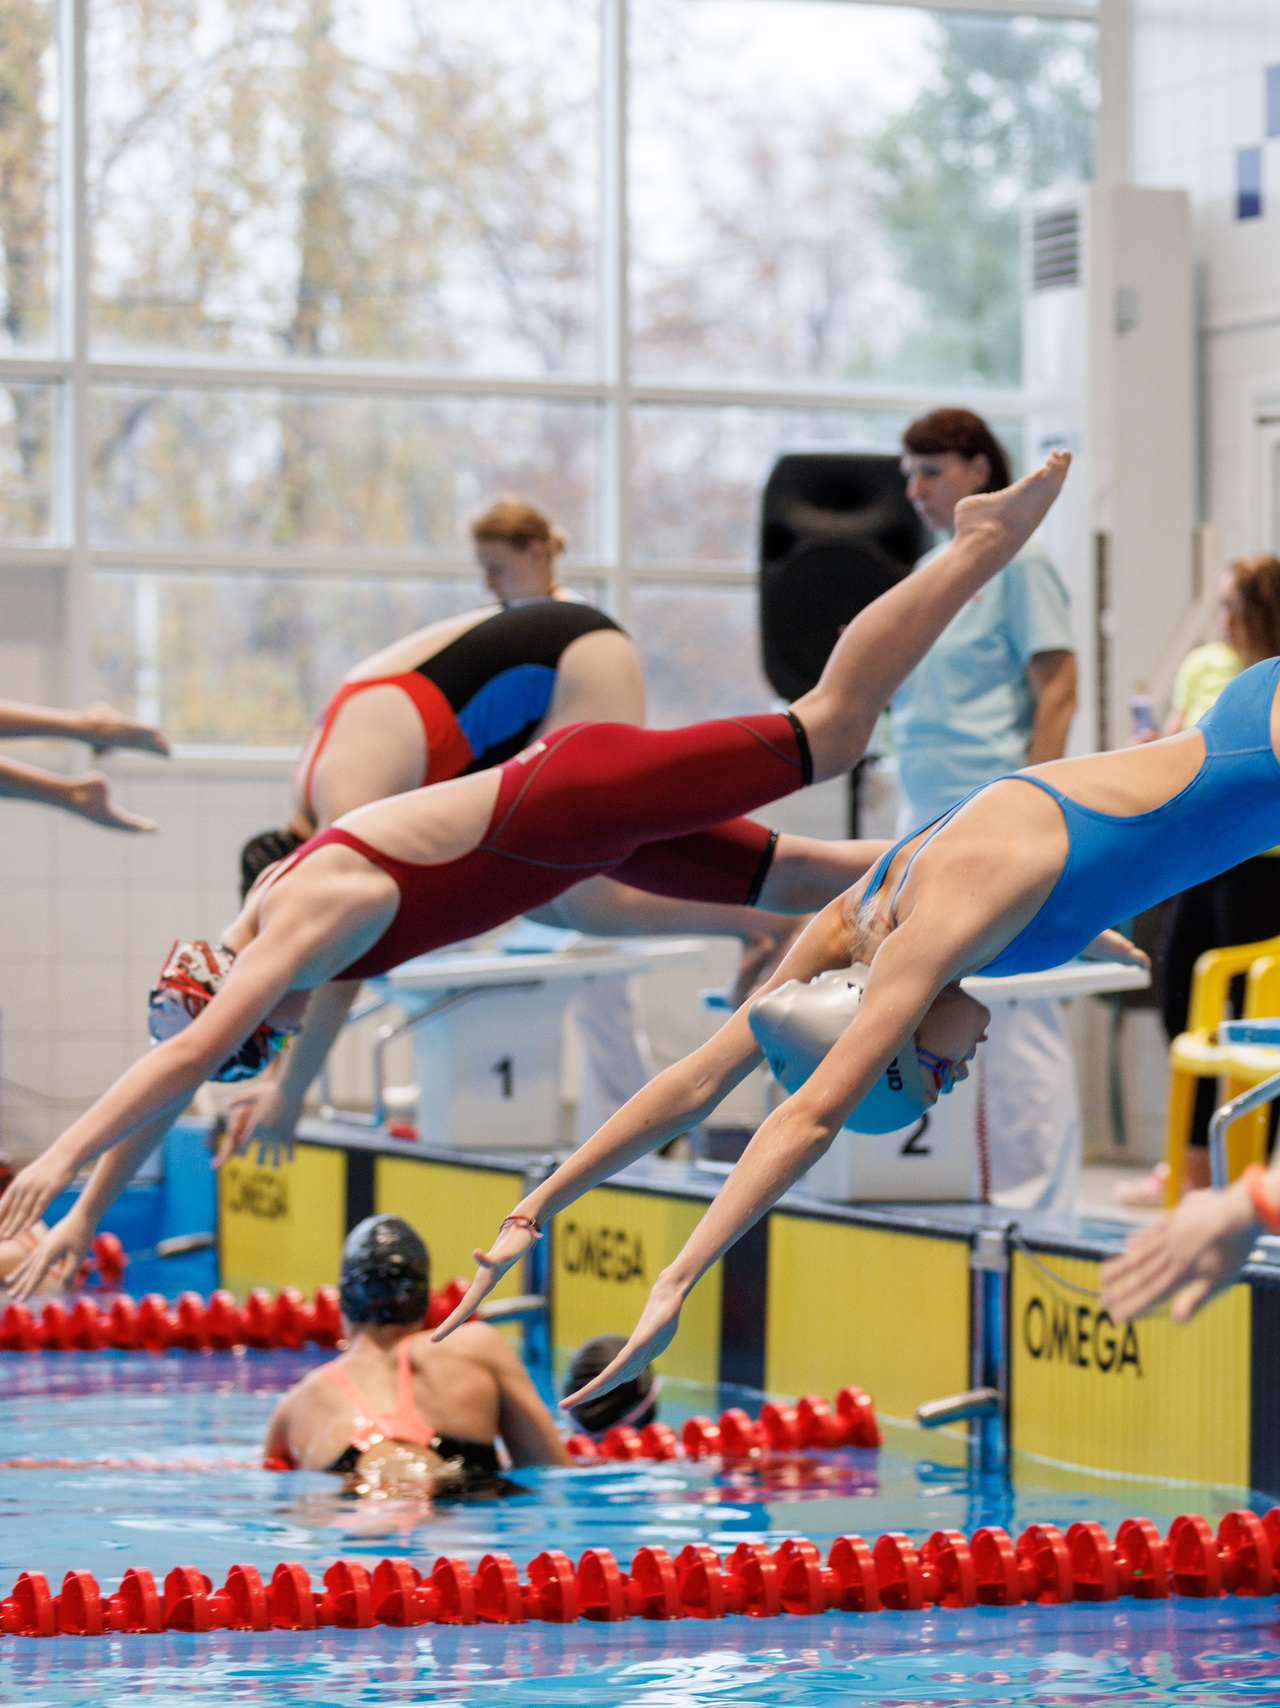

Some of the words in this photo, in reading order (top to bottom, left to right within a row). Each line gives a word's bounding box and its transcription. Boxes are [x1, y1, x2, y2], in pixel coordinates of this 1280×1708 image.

[491, 1057, 512, 1098] 1
[901, 1111, 931, 1156] 2
[563, 1222, 646, 1285] OMEGA
[1023, 1297, 1143, 1379] OMEGA
